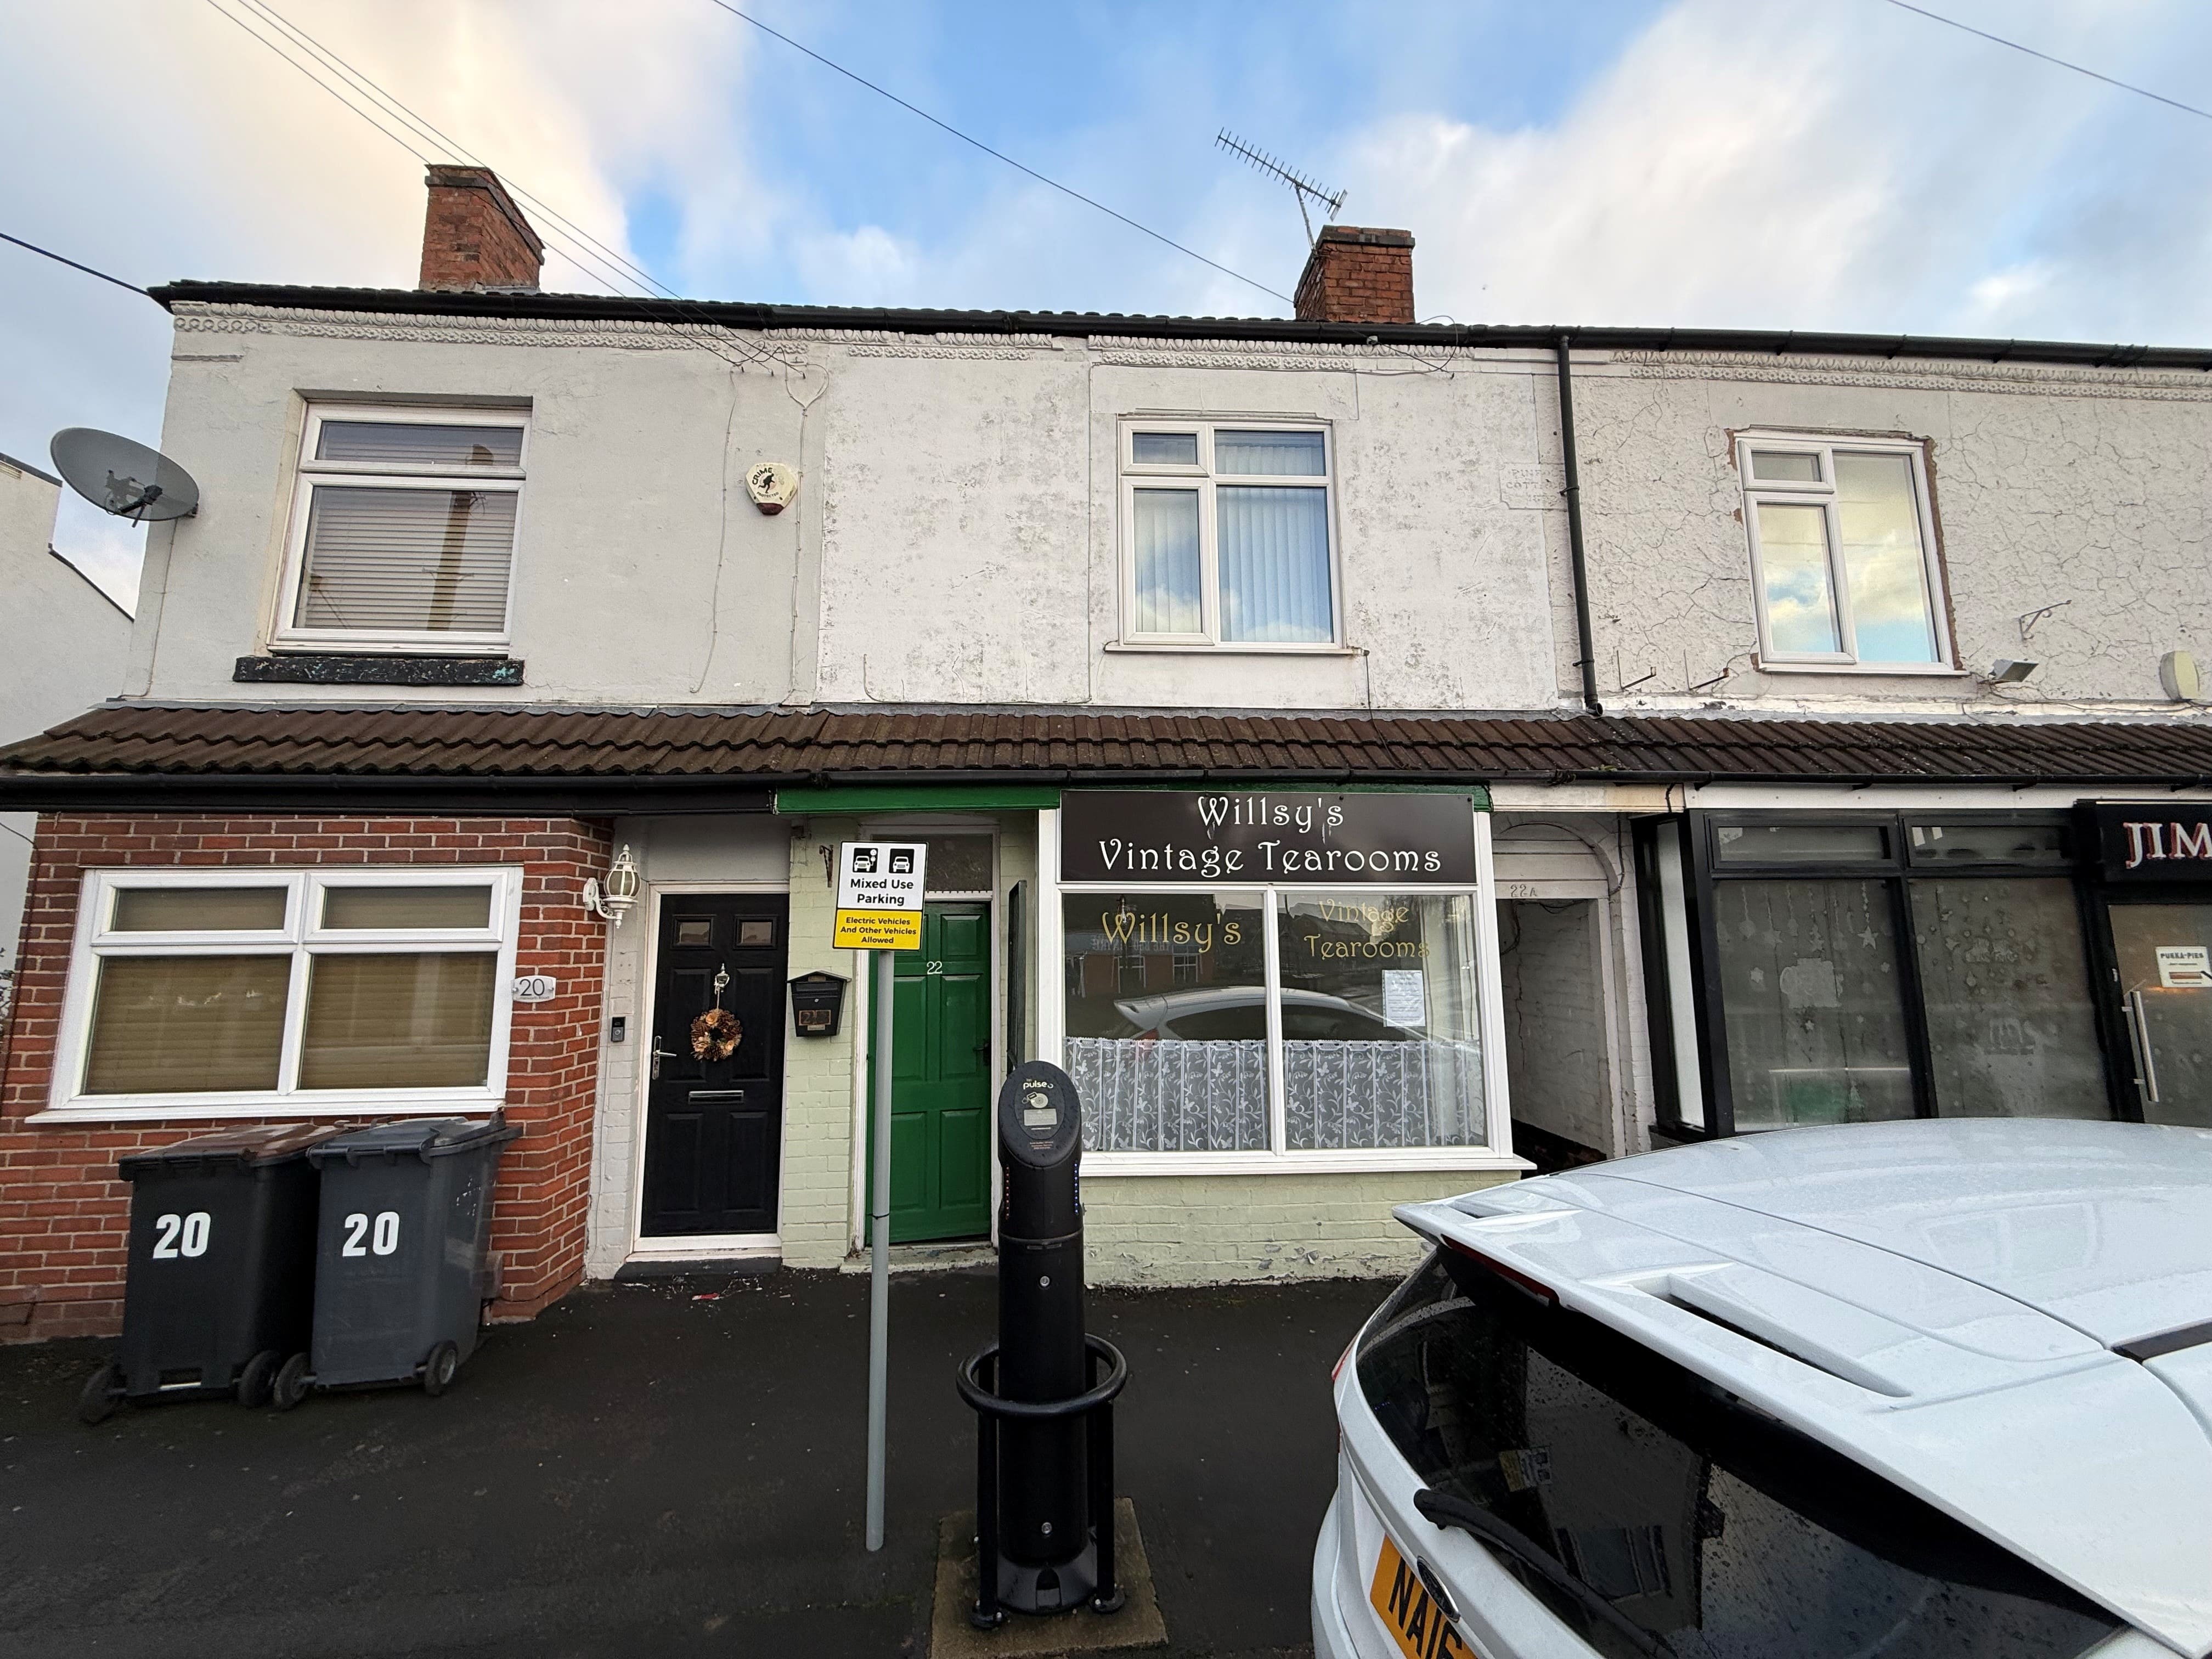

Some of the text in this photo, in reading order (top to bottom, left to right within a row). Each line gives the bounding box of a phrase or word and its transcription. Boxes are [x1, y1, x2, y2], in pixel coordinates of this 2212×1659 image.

[752, 467, 772, 485] CRIME
[1198, 796, 1344, 833] Willsy's
[1099, 838, 1441, 878] Vintage Tearooms
[2123, 822, 2212, 869] JIM
[850, 878, 914, 889] Mixed Use
[1510, 884, 1537, 898] 22A
[857, 894, 905, 906] Parking
[1319, 899, 1409, 933] Vintage
[1102, 912, 1241, 953] Willsy's
[1305, 933, 1430, 960] Tearooms
[927, 961, 943, 975] 22
[520, 979, 545, 996] 20
[1023, 1080, 1047, 1090] pulse
[153, 1212, 211, 1259] 20
[342, 1211, 399, 1257] 20
